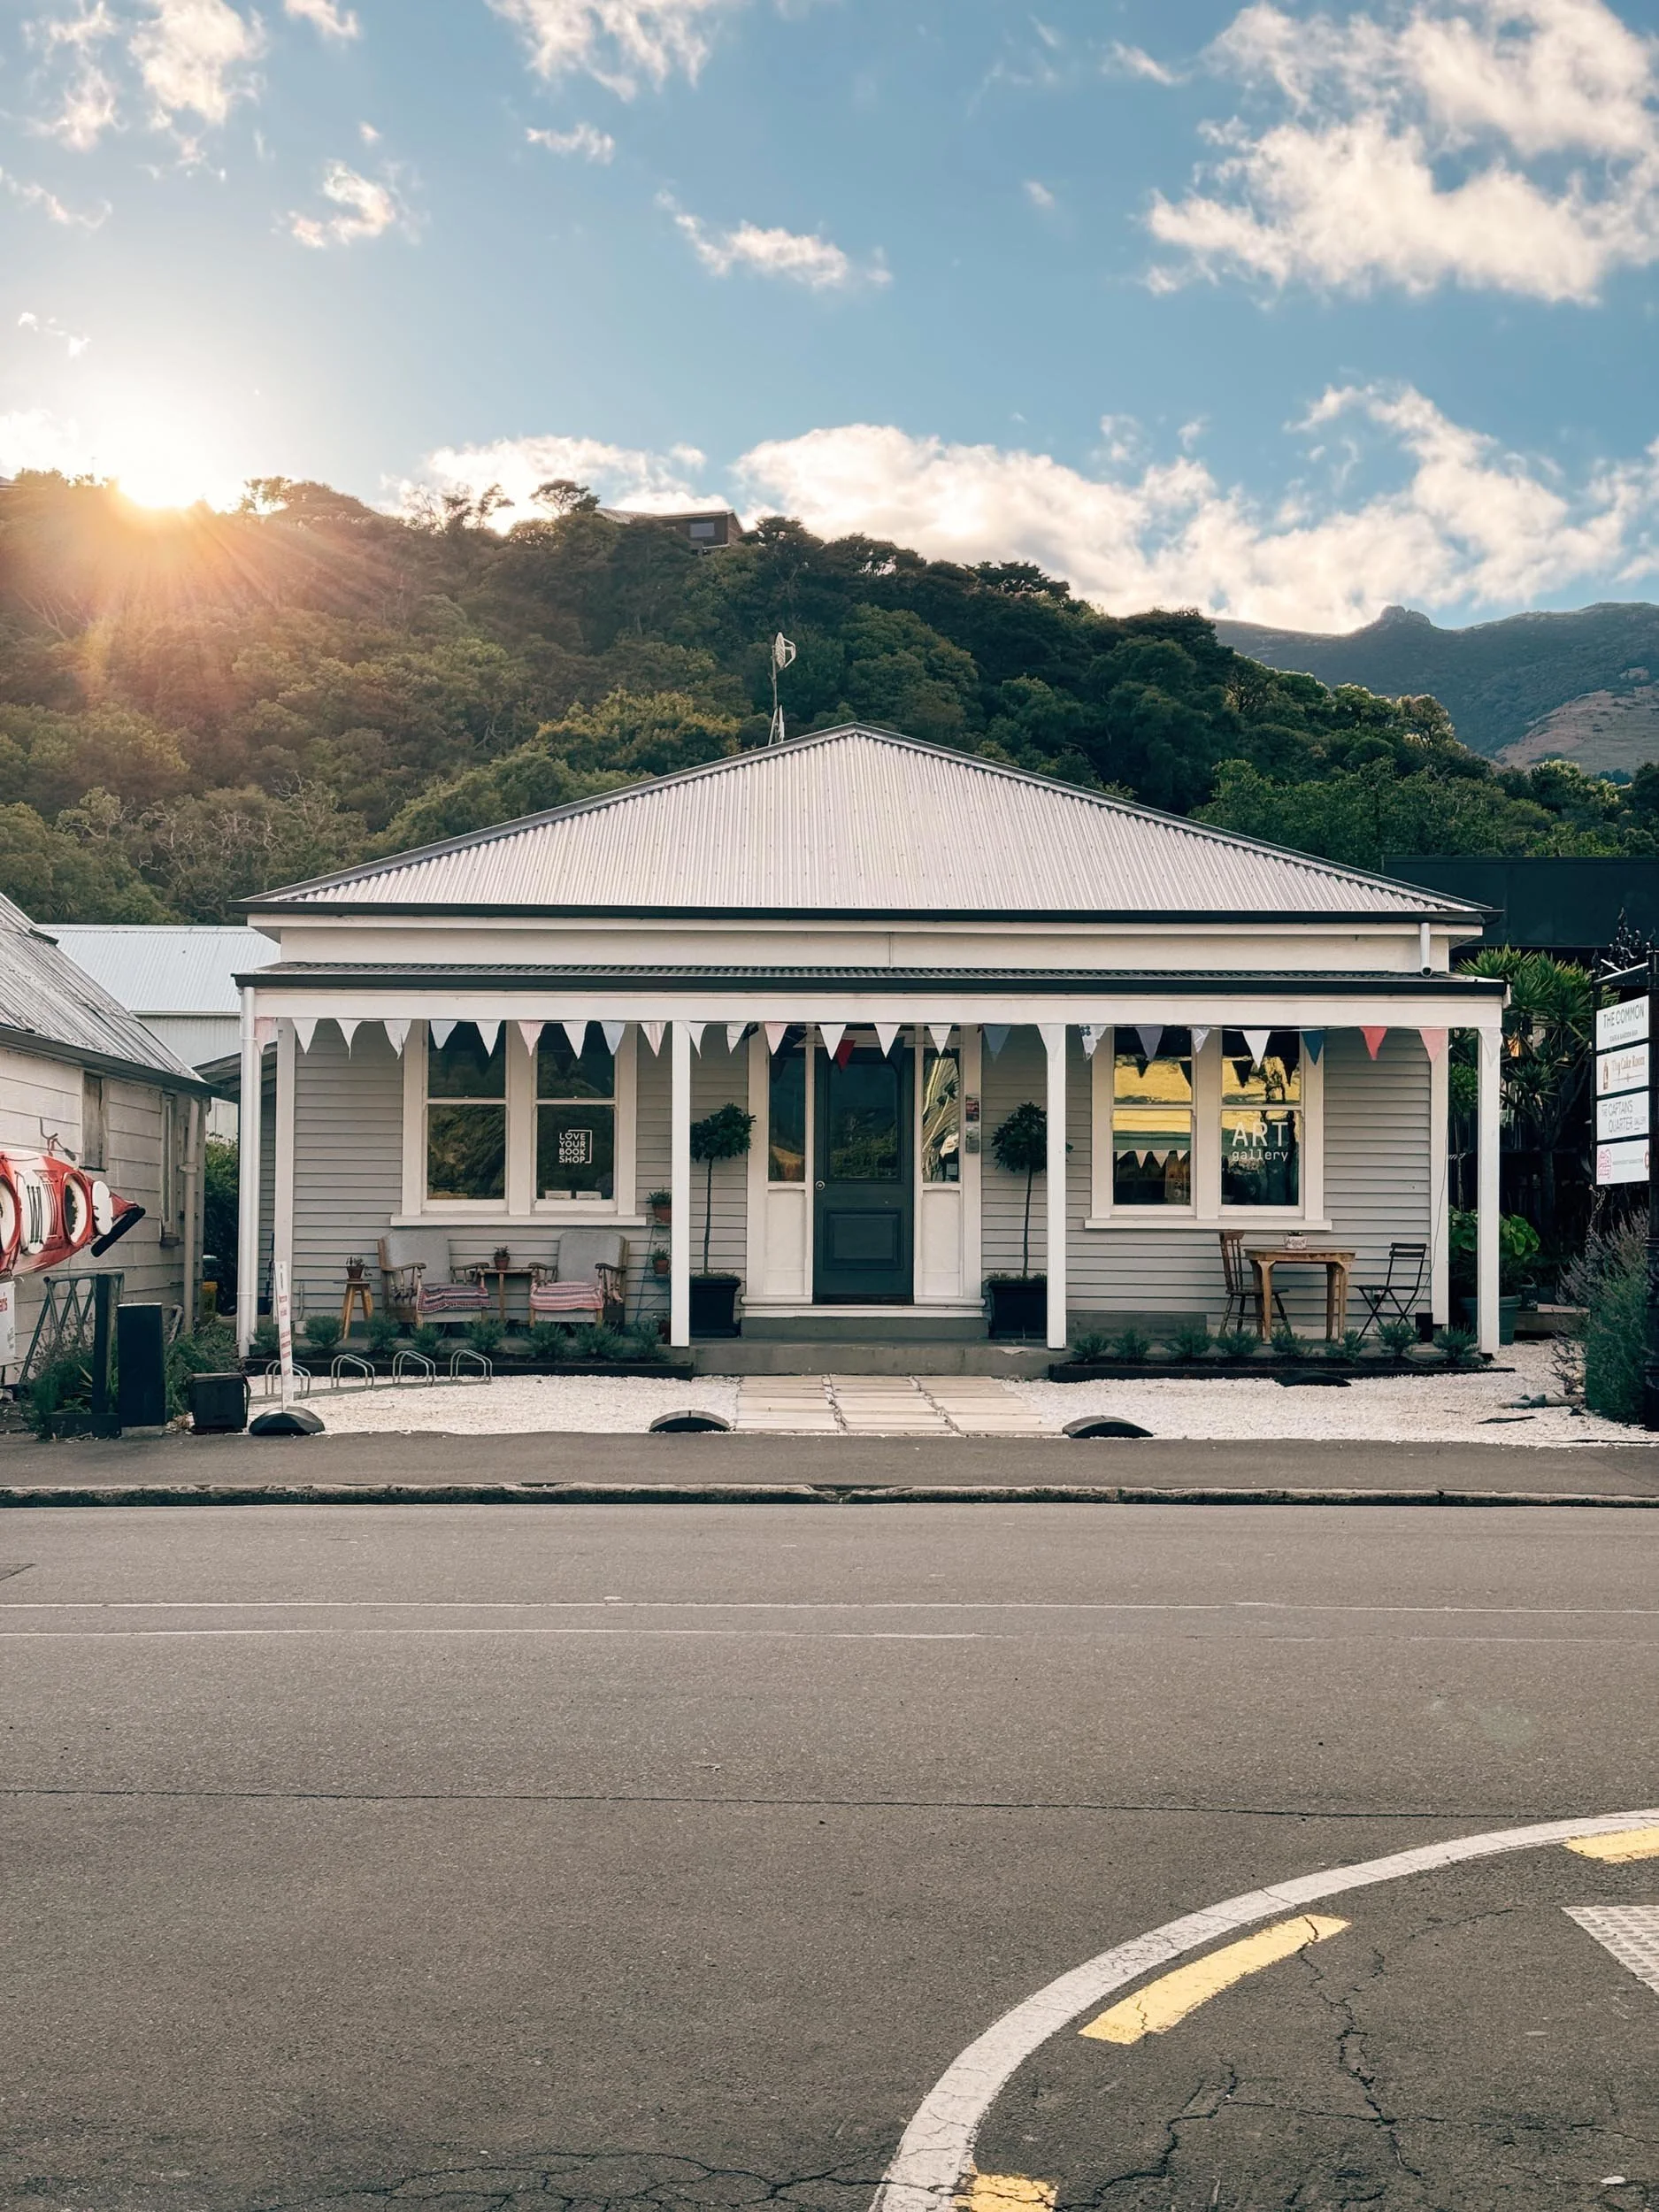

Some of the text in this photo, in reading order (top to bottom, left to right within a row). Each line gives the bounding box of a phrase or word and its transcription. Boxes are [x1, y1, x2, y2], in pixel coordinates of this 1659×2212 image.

[1603, 1002, 1644, 1028] THE COMMON
[559, 1140, 586, 1148] YOUR
[1232, 1121, 1288, 1147] ART
[1232, 1148, 1288, 1162] gallery
